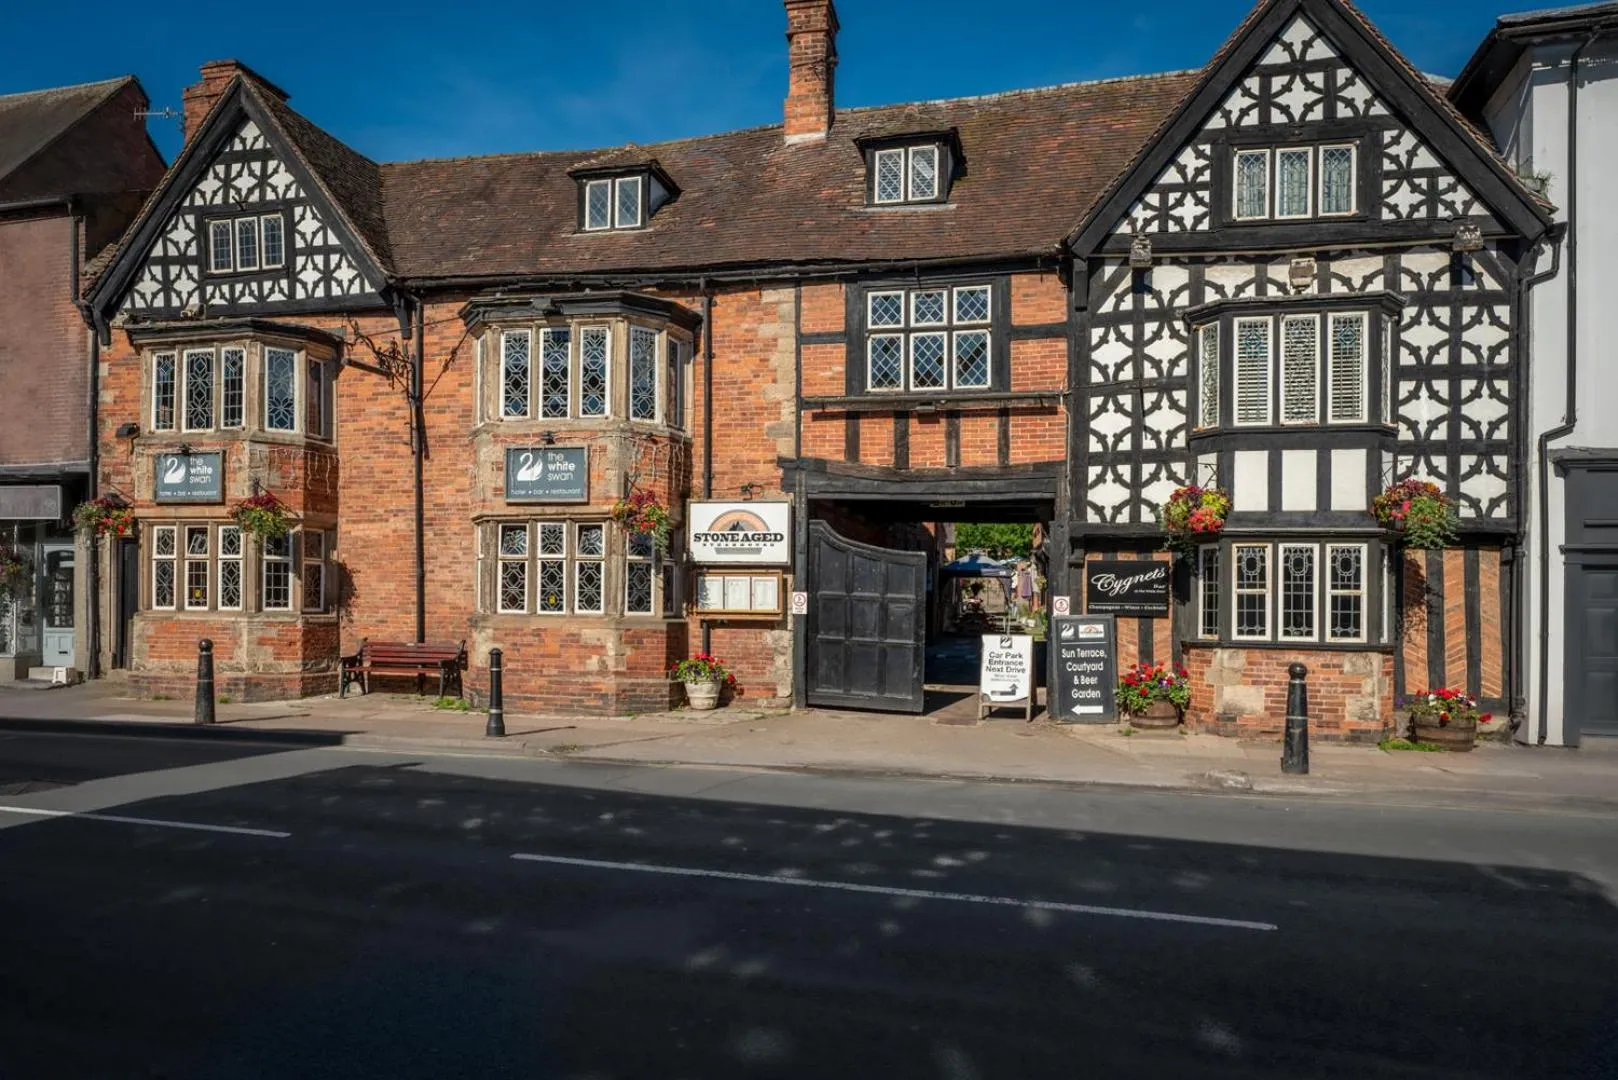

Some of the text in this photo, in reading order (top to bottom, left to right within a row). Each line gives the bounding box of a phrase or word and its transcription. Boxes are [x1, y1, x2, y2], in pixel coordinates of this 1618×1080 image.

[548, 452, 564, 461] the
[189, 457, 204, 466] the
[547, 461, 576, 471] white
[189, 466, 213, 475] white
[189, 475, 212, 484] swan
[547, 472, 574, 481] swan
[1090, 567, 1166, 597] Cygnets
[1005, 651, 1023, 659] Park
[1061, 648, 1107, 658] Sun Terrace,
[988, 658, 1024, 666] Entrance
[1066, 661, 1104, 673] Courtyard
[1073, 675, 1098, 685] & Beer
[1071, 688, 1101, 698] Garden
